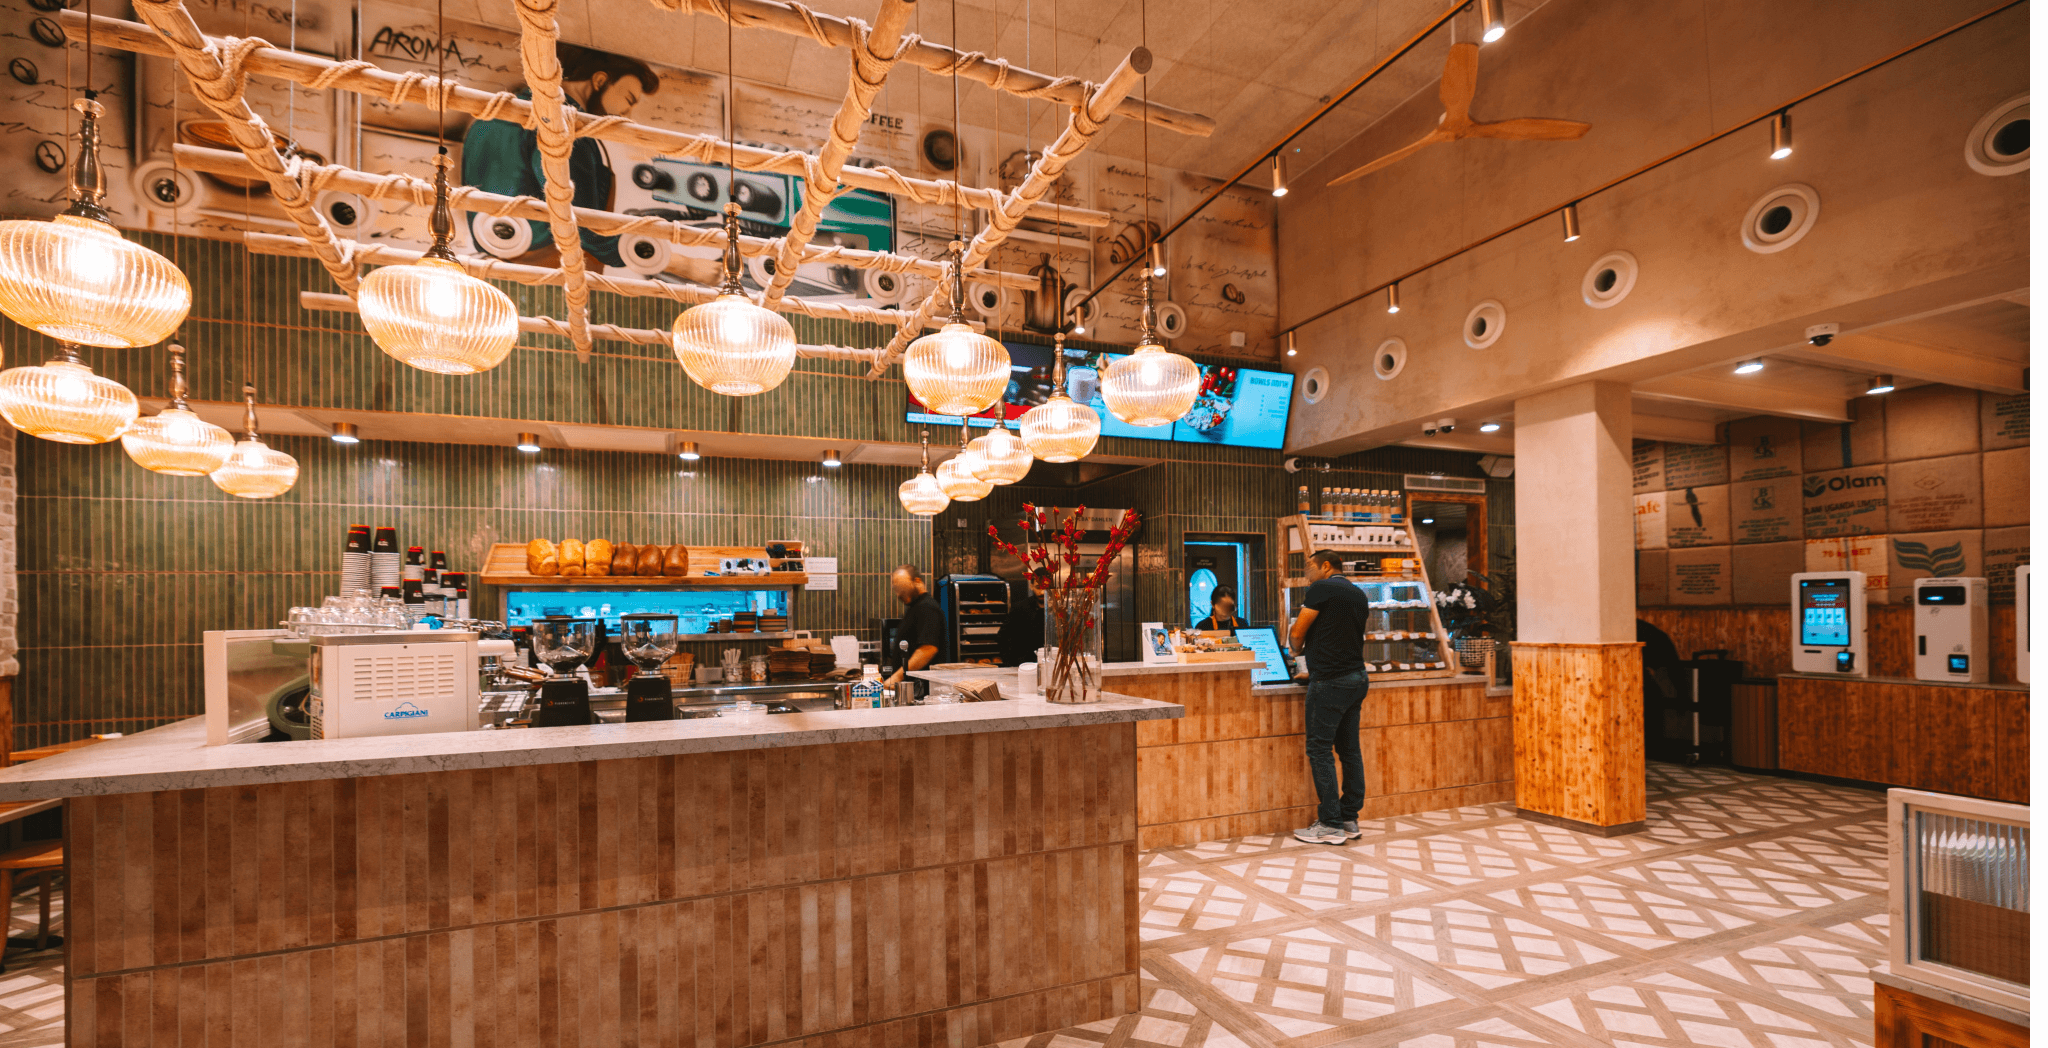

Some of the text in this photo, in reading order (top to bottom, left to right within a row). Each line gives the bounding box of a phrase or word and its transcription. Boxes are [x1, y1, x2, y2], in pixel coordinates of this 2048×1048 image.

[368, 26, 465, 68] AROMA
[1828, 475, 1886, 491] Olam
[1824, 501, 1855, 512] UGANDA
[384, 710, 429, 718] CARPIGIANI
